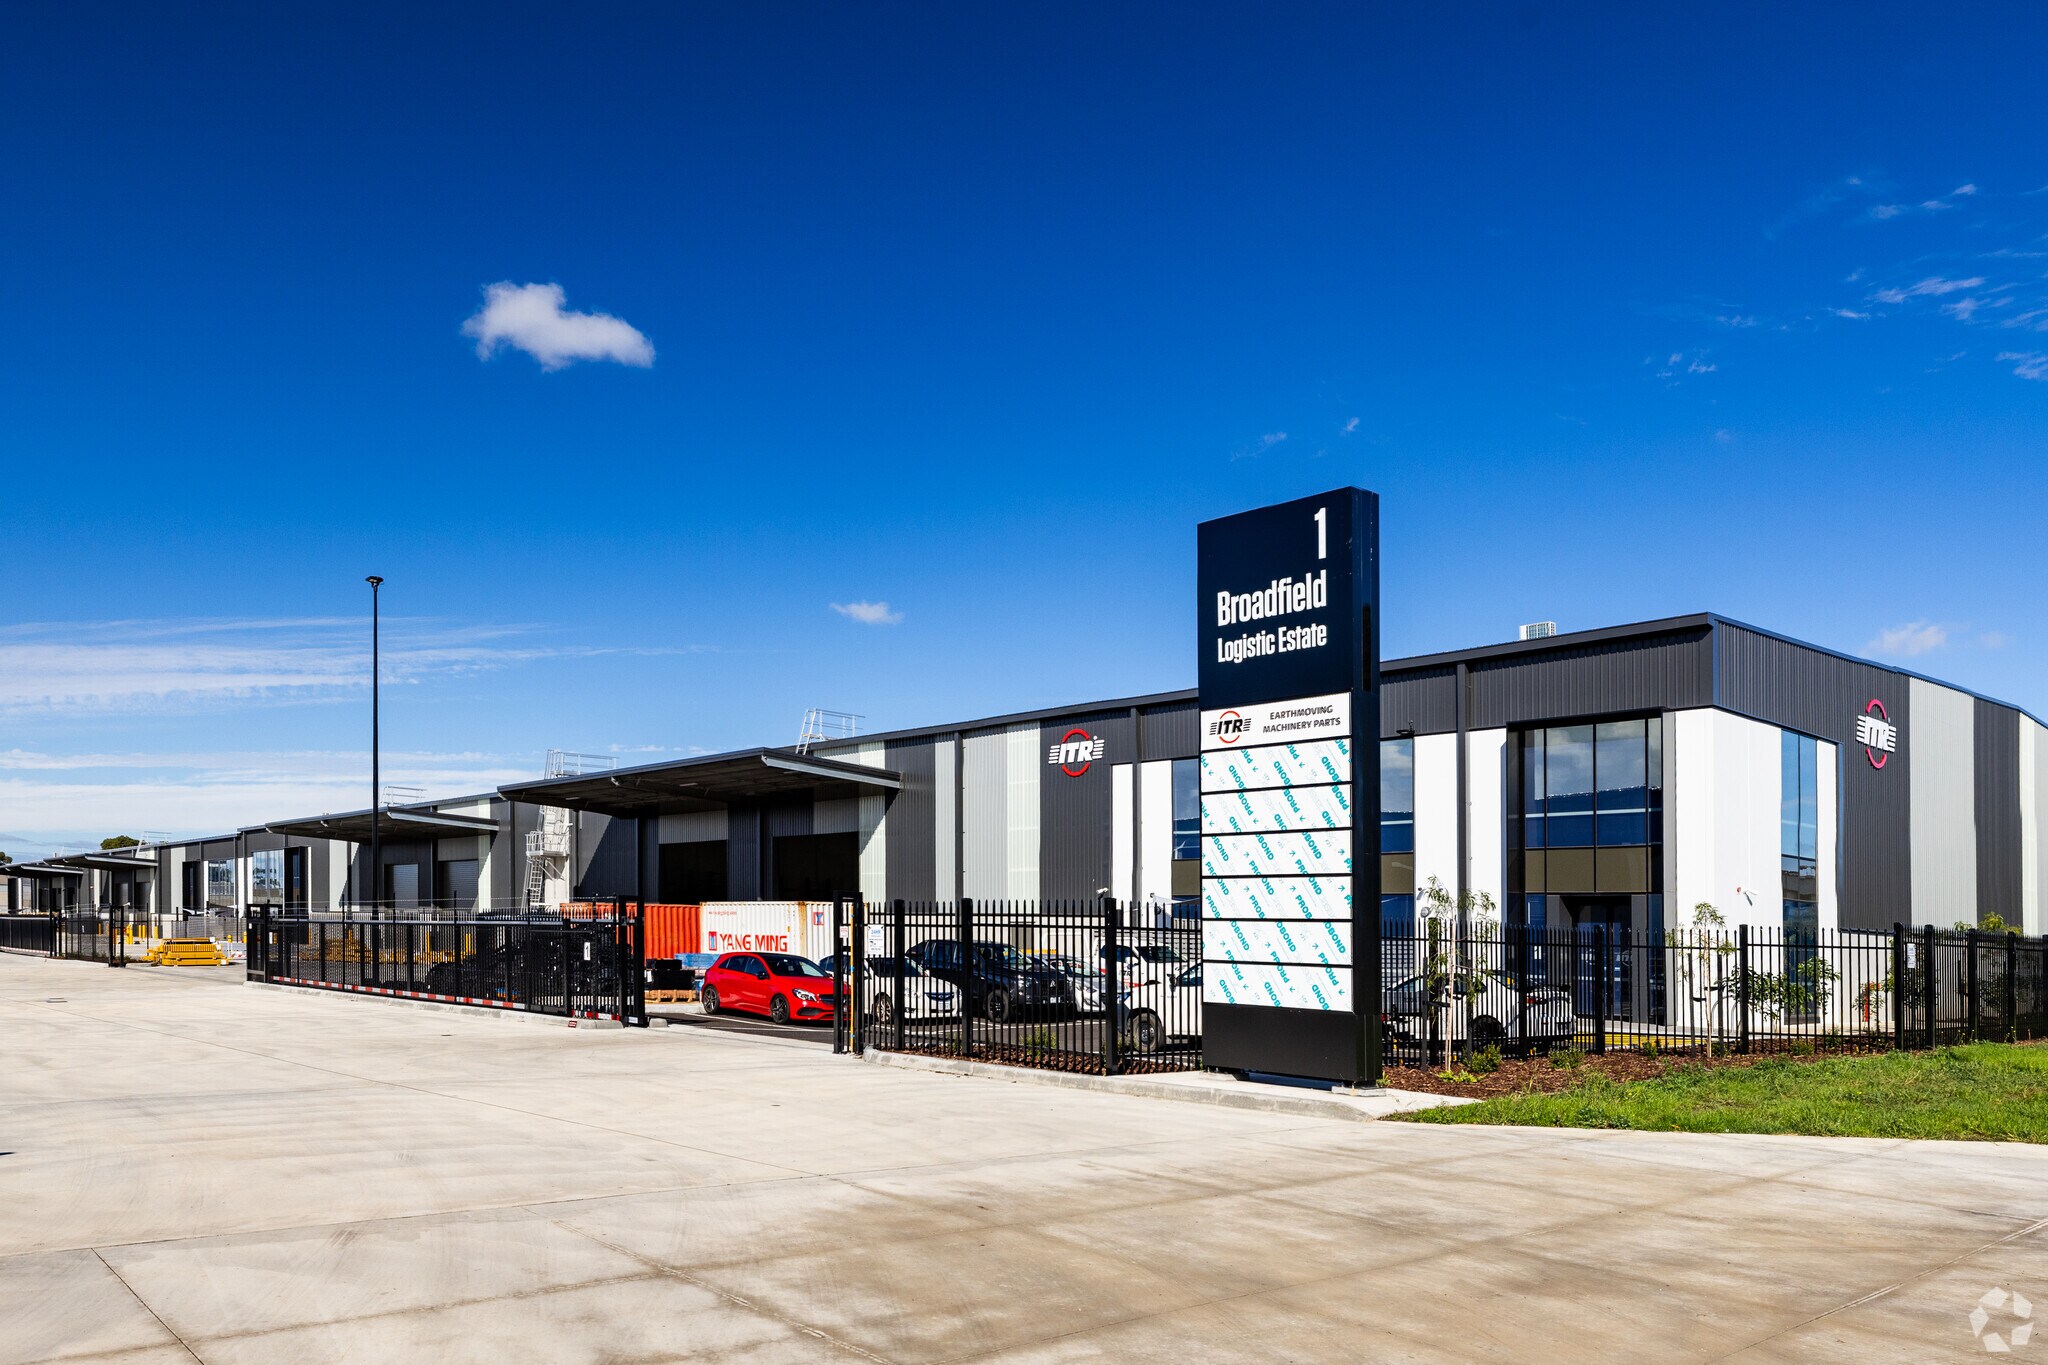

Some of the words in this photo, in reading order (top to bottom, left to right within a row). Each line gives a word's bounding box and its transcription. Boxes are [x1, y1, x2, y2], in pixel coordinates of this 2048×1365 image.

[1314, 507, 1327, 560] 1
[1217, 569, 1327, 627] Broadfield
[1217, 629, 1276, 664] Logistic
[1277, 623, 1328, 653] Estate
[1262, 720, 1312, 734] MACHINERY
[1313, 717, 1341, 728] PARTS
[1269, 704, 1333, 720] EARTHMOVING
[719, 934, 751, 951] YANG
[755, 935, 788, 952] MING
